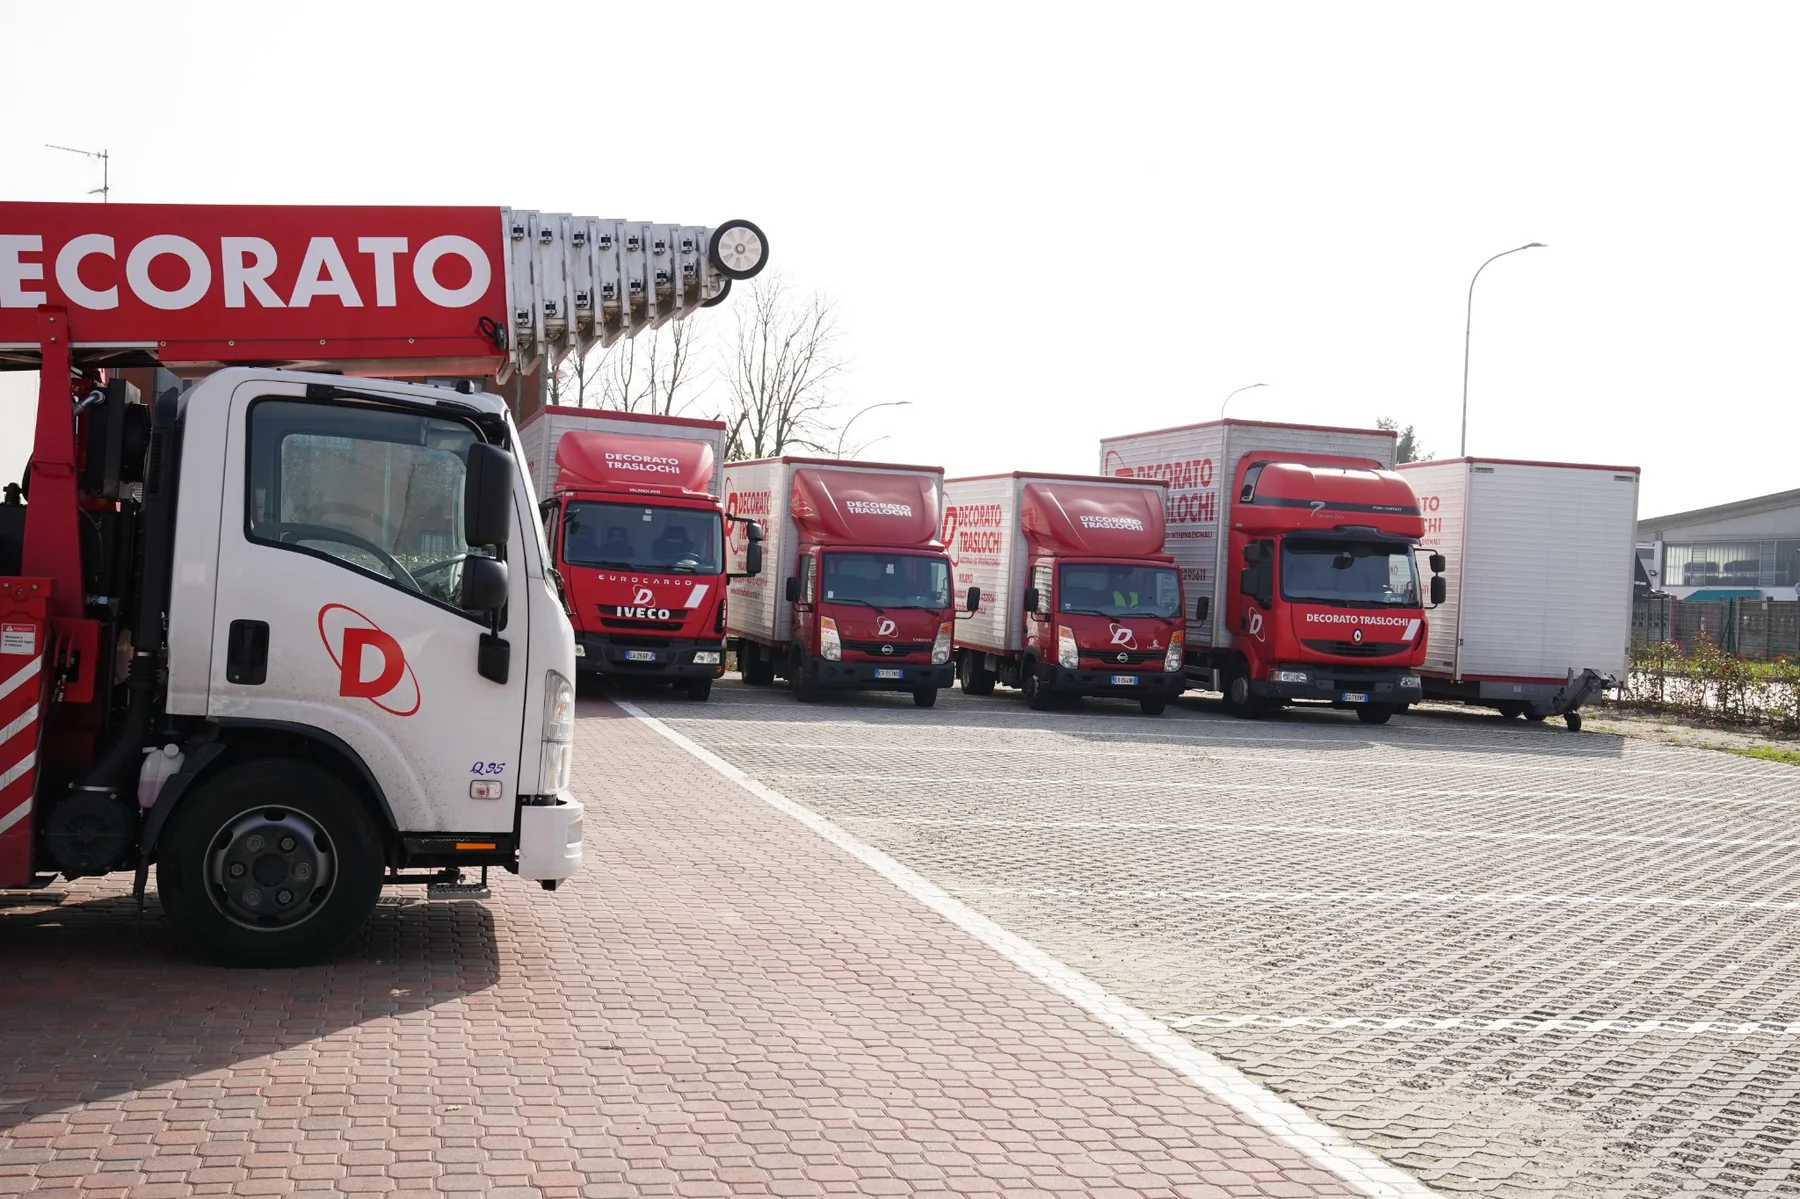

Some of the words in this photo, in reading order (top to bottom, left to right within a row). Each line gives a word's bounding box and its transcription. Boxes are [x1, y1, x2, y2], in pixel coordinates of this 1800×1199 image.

[605, 453, 679, 465] DECORATO
[606, 461, 680, 474] TRASLOCHI
[847, 501, 911, 511] DECORATO
[848, 507, 912, 517] TRASLOCHI
[959, 504, 1002, 527] DECORATO
[1080, 516, 1142, 525] DECORATO
[1082, 522, 1144, 531] TRASLOCHI
[960, 531, 1002, 553] TRASLOCHI
[598, 574, 692, 586] EUROCARGO
[616, 606, 670, 620] IVECO
[1306, 613, 1358, 624] DECORATO
[1360, 615, 1408, 626] TRASLOCHI
